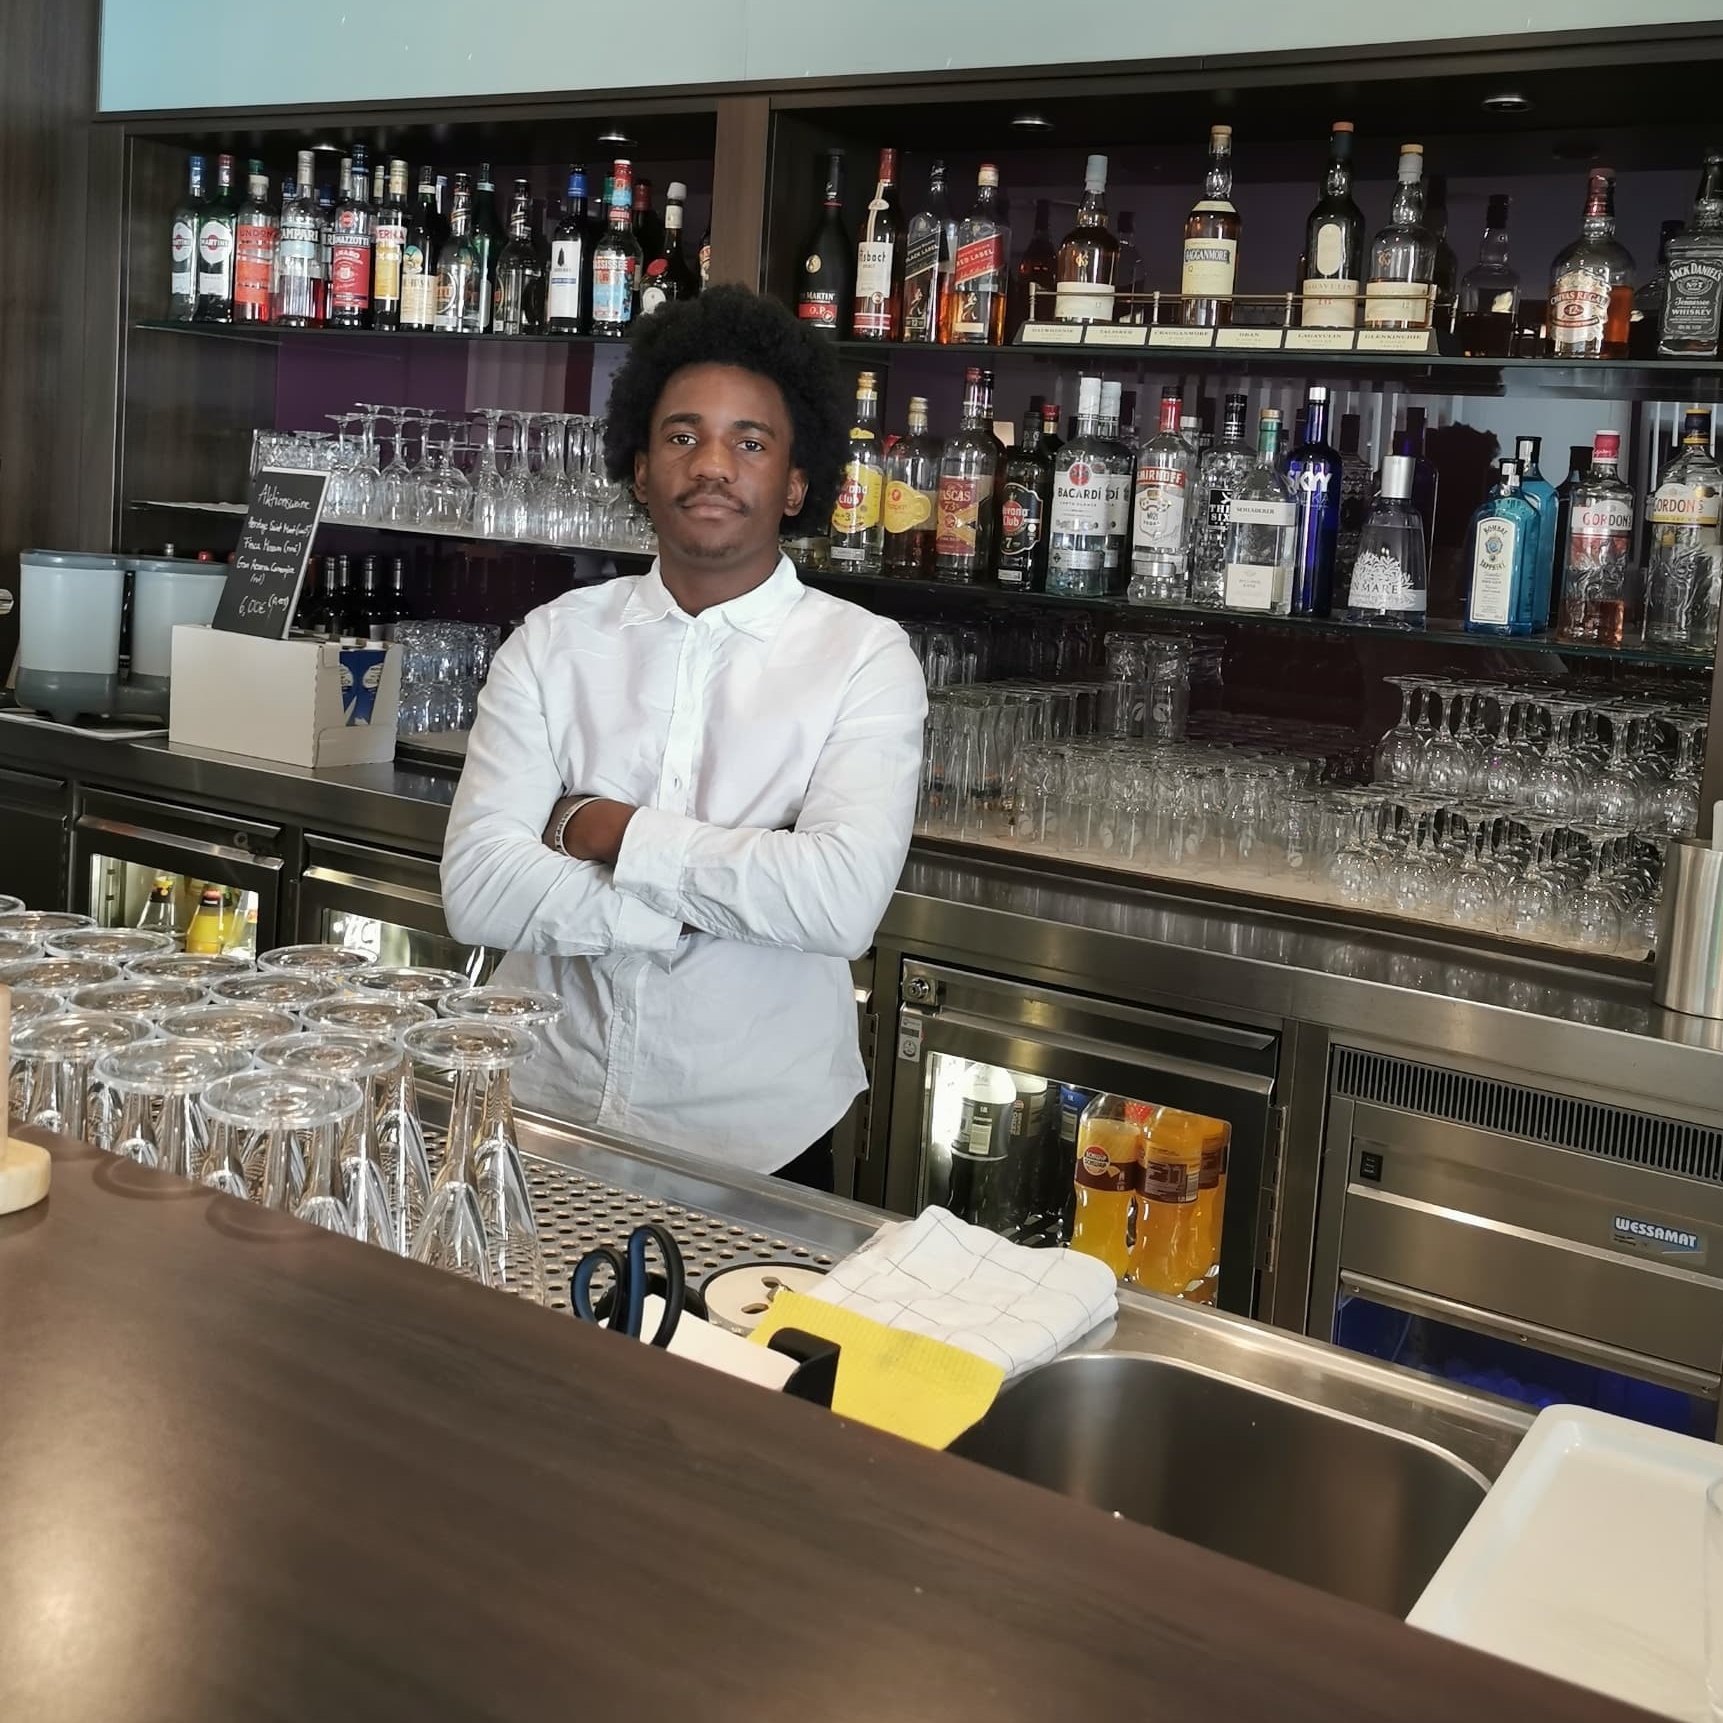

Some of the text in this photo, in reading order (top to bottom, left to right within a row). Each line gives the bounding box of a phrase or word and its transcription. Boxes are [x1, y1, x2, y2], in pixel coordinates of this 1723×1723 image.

[970, 249, 993, 260] LABEL
[1669, 265, 1690, 281] JACK
[943, 490, 970, 501] ASCAS
[1363, 582, 1398, 594] MARE
[1615, 1217, 1697, 1248] WESSAMAT
